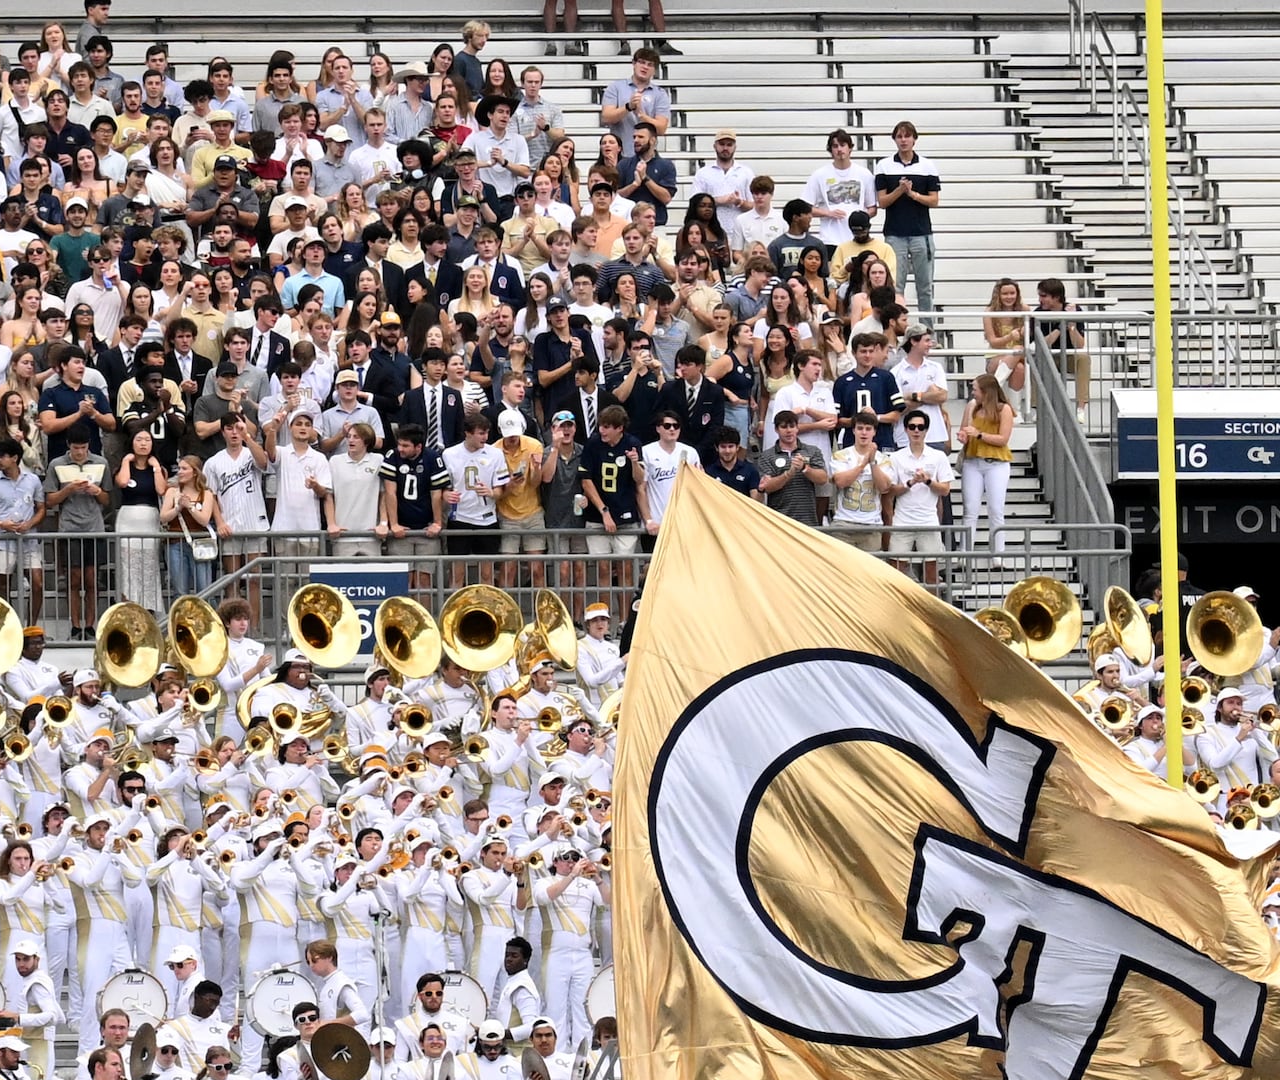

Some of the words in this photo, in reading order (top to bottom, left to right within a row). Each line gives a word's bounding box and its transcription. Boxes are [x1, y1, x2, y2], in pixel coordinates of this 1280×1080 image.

[1176, 444, 1208, 468] 16
[403, 474, 418, 500] 0
[601, 462, 619, 492] 8
[654, 467, 677, 482] Jack
